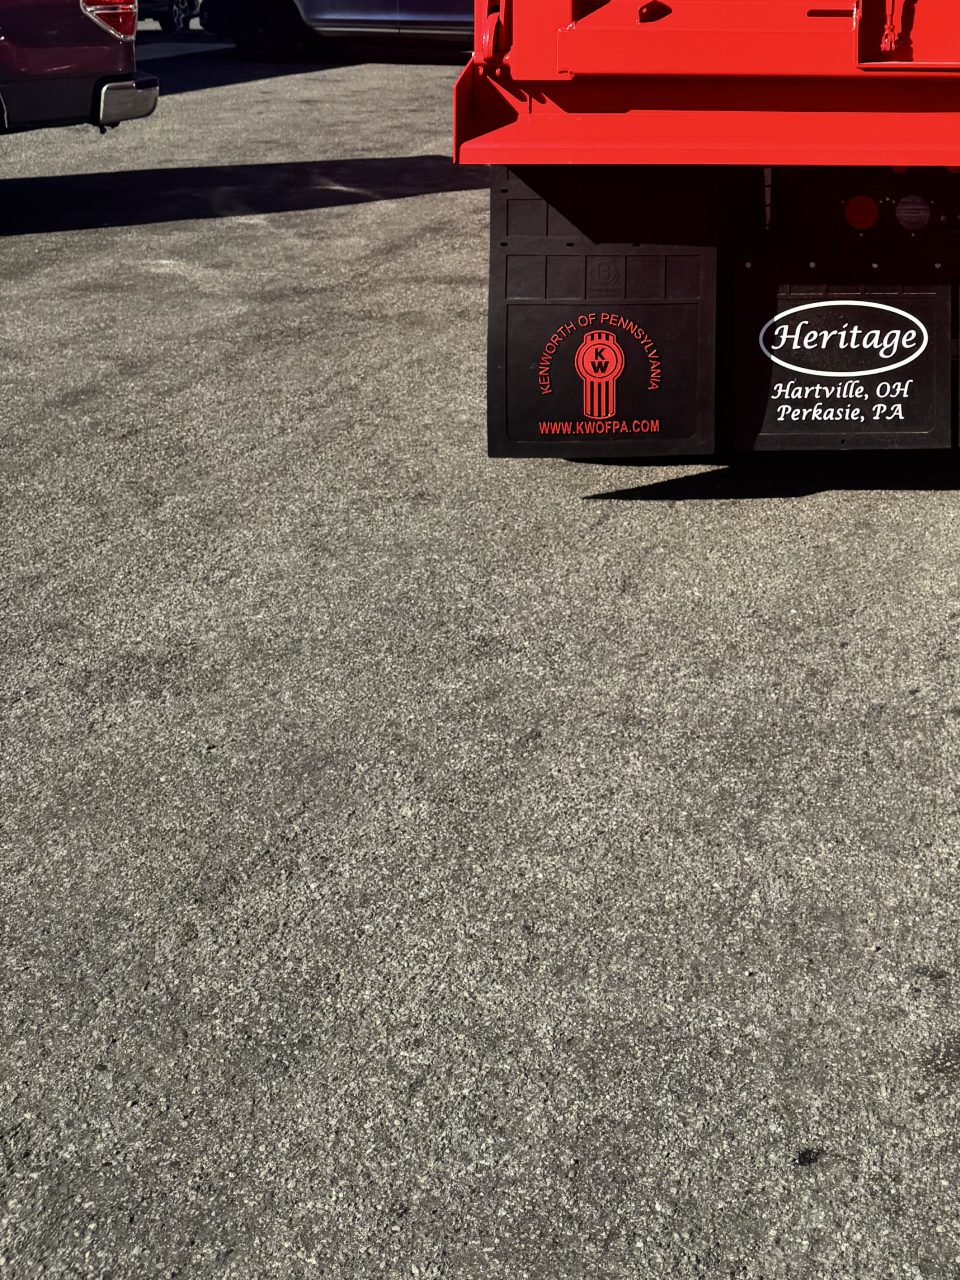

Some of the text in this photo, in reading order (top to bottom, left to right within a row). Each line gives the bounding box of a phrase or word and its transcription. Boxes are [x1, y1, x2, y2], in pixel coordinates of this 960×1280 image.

[771, 320, 917, 359] Heritage
[538, 312, 661, 395] KENWORTH OF PENNSYLVANIA
[771, 379, 914, 401] Hartville, OH
[776, 402, 905, 422] Perkasie, PA
[538, 419, 660, 435] WWW.KWOFPA.COM
